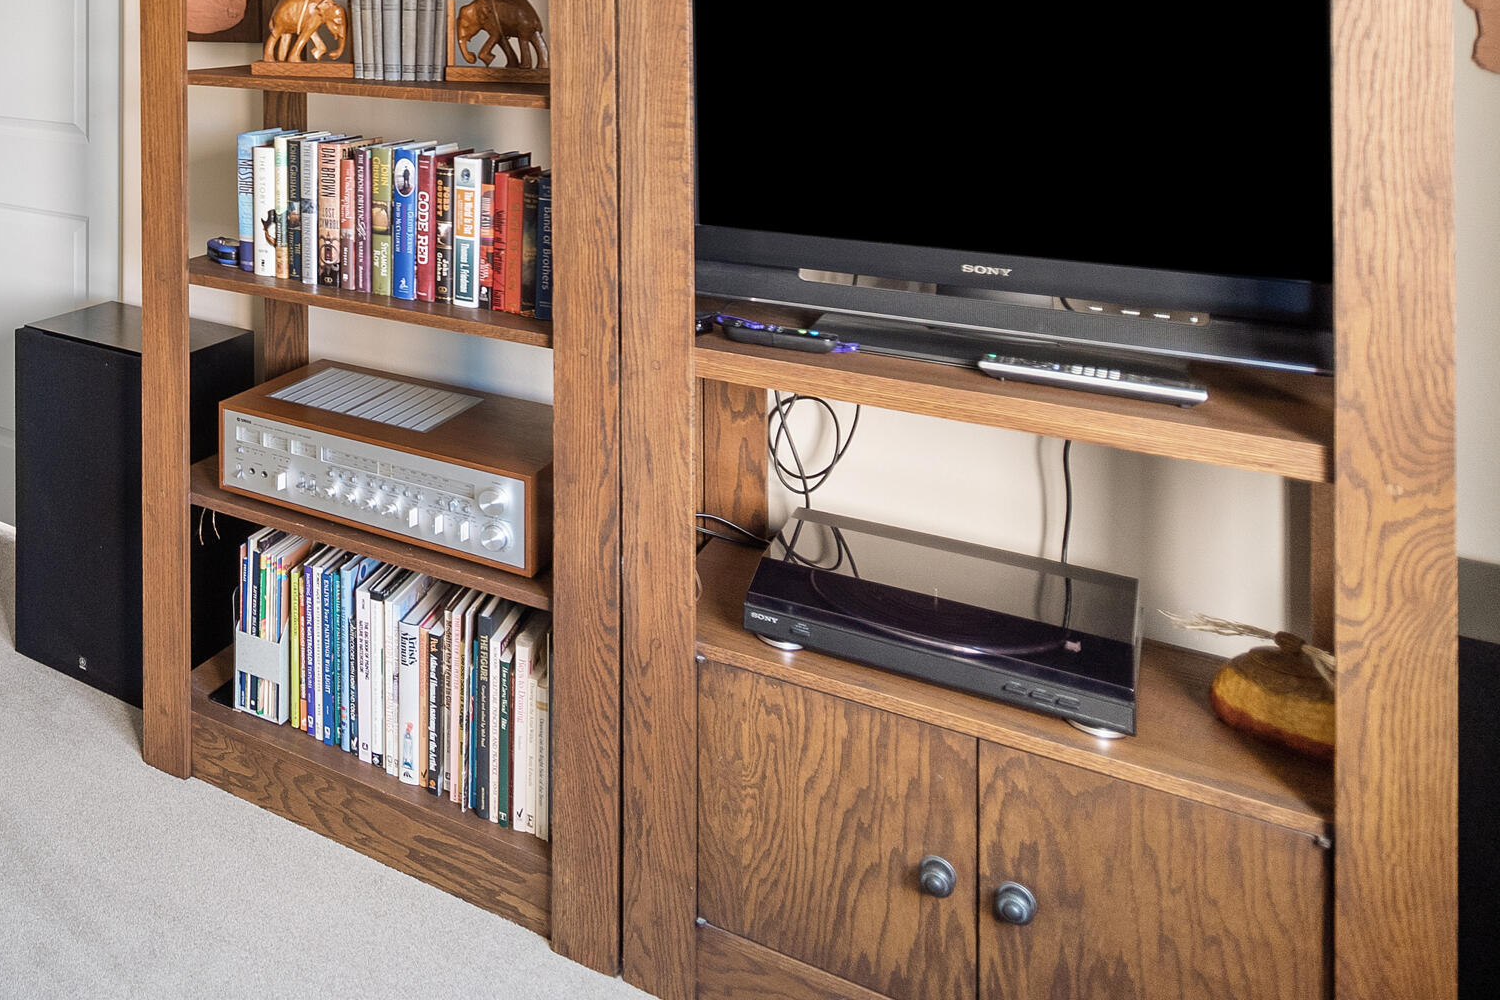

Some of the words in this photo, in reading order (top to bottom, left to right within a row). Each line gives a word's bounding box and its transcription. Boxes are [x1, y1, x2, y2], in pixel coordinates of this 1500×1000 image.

[289, 142, 298, 164] JOHN
[238, 158, 254, 196] MESSAGE
[290, 165, 299, 199] GRISHAM
[303, 159, 312, 196] BRETHREN
[321, 167, 336, 198] BROWN
[372, 156, 381, 195] GRISHAM
[381, 164, 390, 187] JOHN
[345, 176, 354, 219] Underground
[443, 186, 451, 212] FORD
[463, 201, 474, 217] World
[303, 216, 312, 236] JOHN
[417, 191, 430, 233] CODE
[493, 209, 506, 235] Soldier
[543, 206, 551, 231] Band
[303, 237, 312, 269] GRISHAM
[380, 241, 389, 278] SYCAMORE
[459, 242, 471, 262] Thomas
[493, 247, 506, 275] Fortune
[442, 258, 451, 278] John
[458, 269, 470, 293] Friedman
[542, 248, 551, 291] Brothers
[961, 264, 1012, 277] SONY
[306, 596, 314, 625] REALISTIC
[750, 611, 778, 624] SONY
[307, 626, 315, 666] WATERCOLOR
[400, 632, 409, 667] Manual
[408, 635, 418, 666] Artist's
[430, 637, 438, 652] Peck
[430, 653, 438, 671] Atlas
[480, 650, 489, 682] FIGURE
[516, 658, 527, 679] Keys
[430, 679, 438, 703] Human
[428, 703, 438, 731] Anatomy
[516, 690, 527, 724] Drawing
[430, 752, 438, 771] Artist
